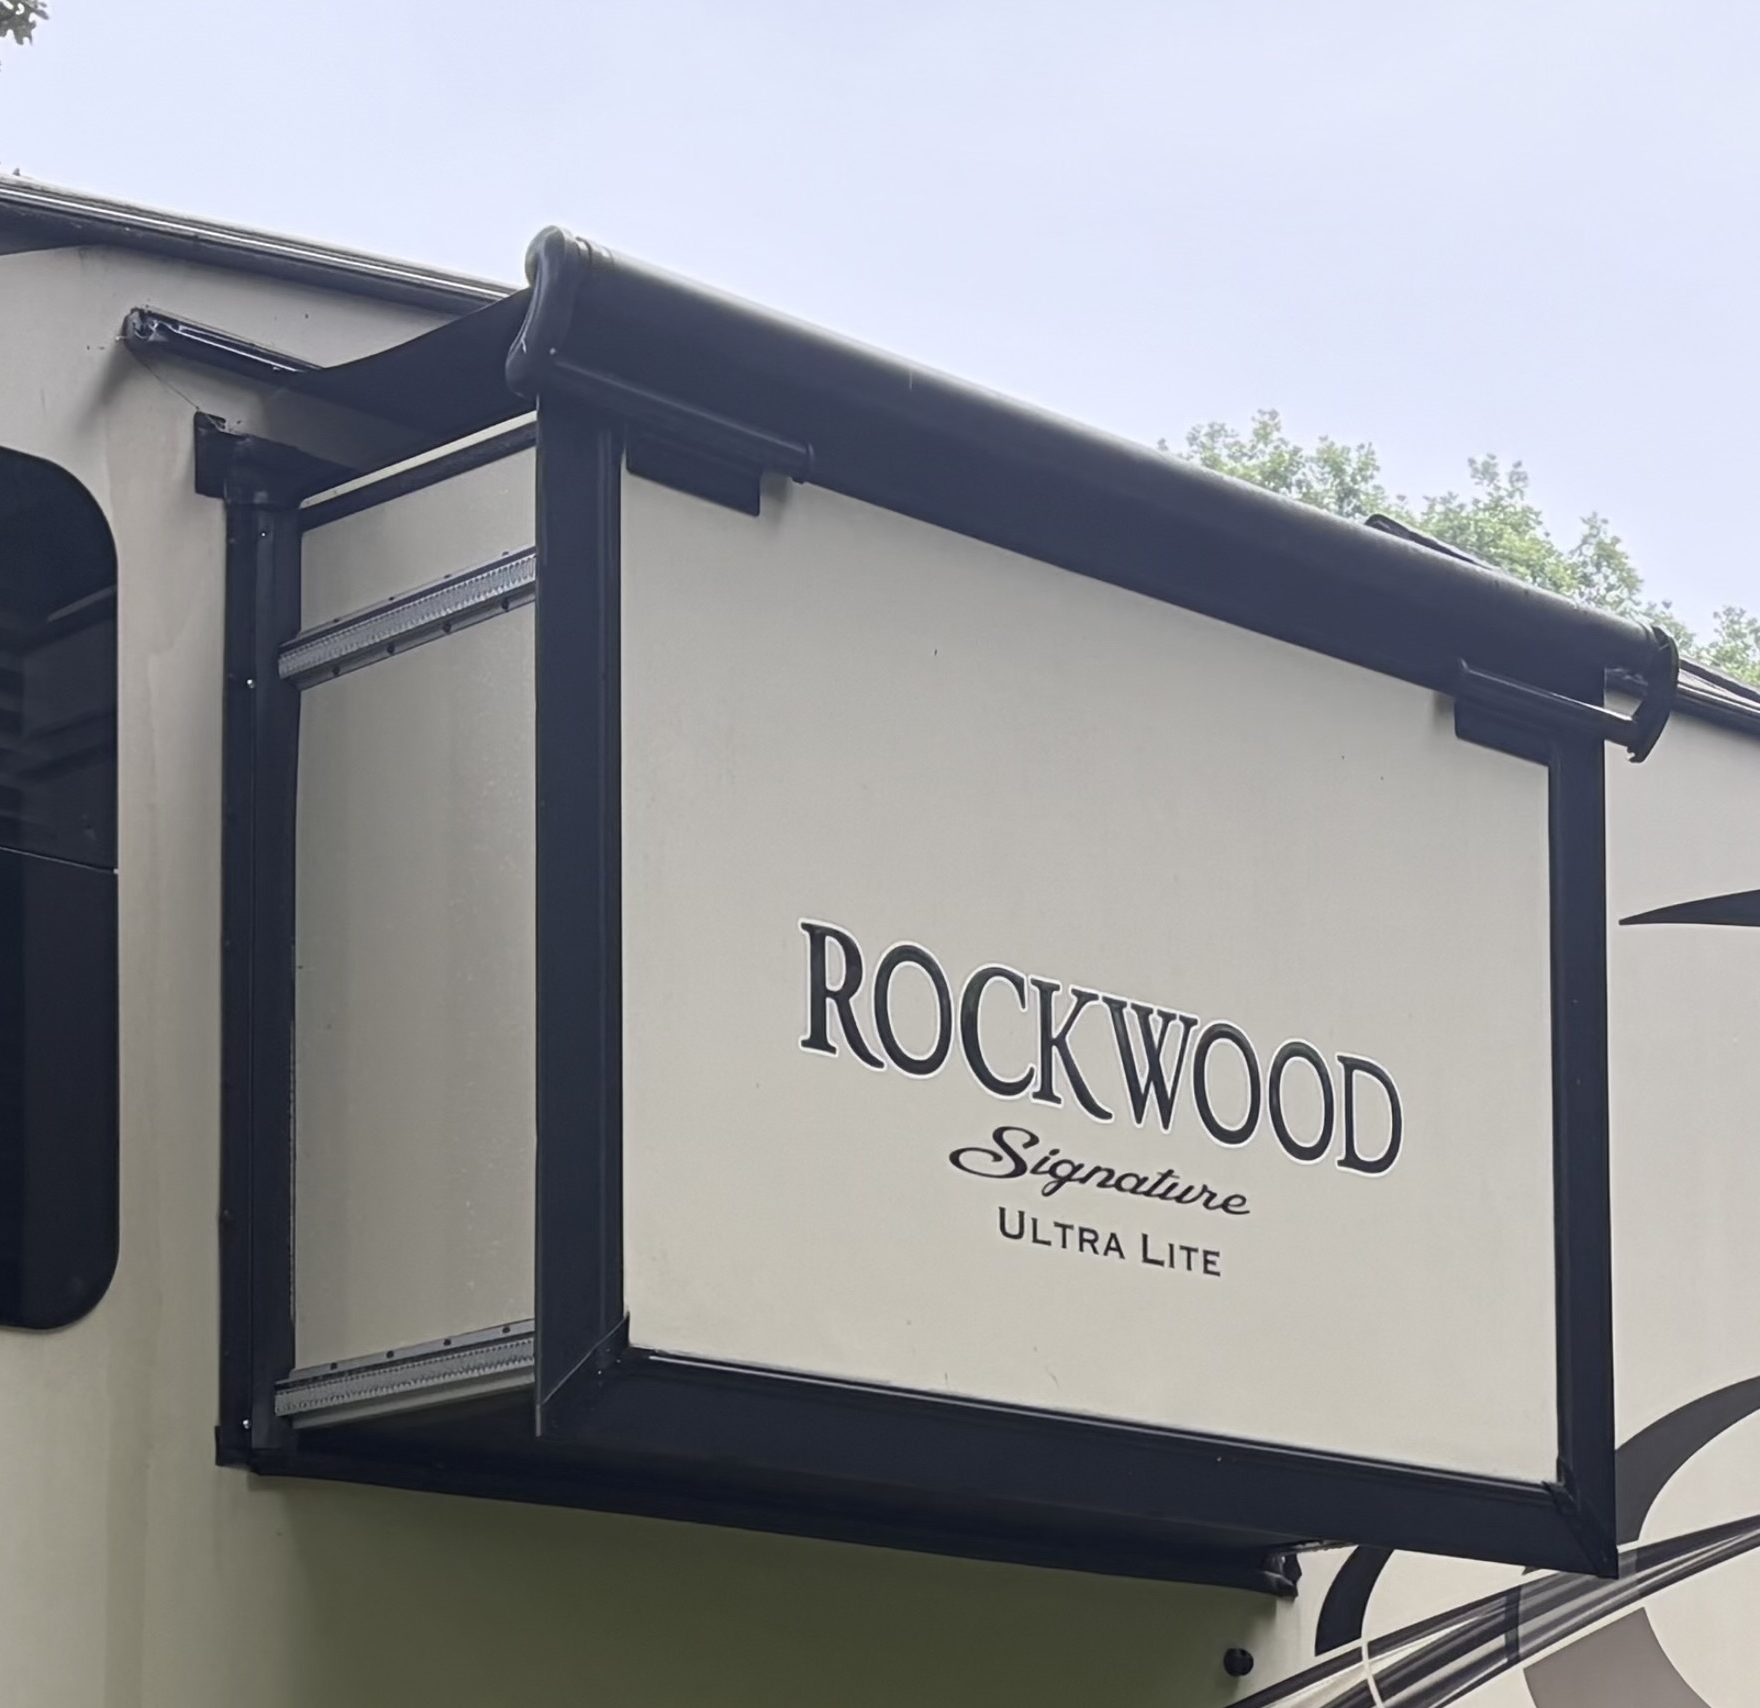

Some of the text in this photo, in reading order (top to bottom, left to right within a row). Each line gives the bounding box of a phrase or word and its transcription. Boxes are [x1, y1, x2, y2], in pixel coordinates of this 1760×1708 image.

[800, 919, 1403, 1176] ROCKWOOD
[948, 1125, 1251, 1217] Signature
[998, 1206, 1222, 1278] ULTRA LITE
